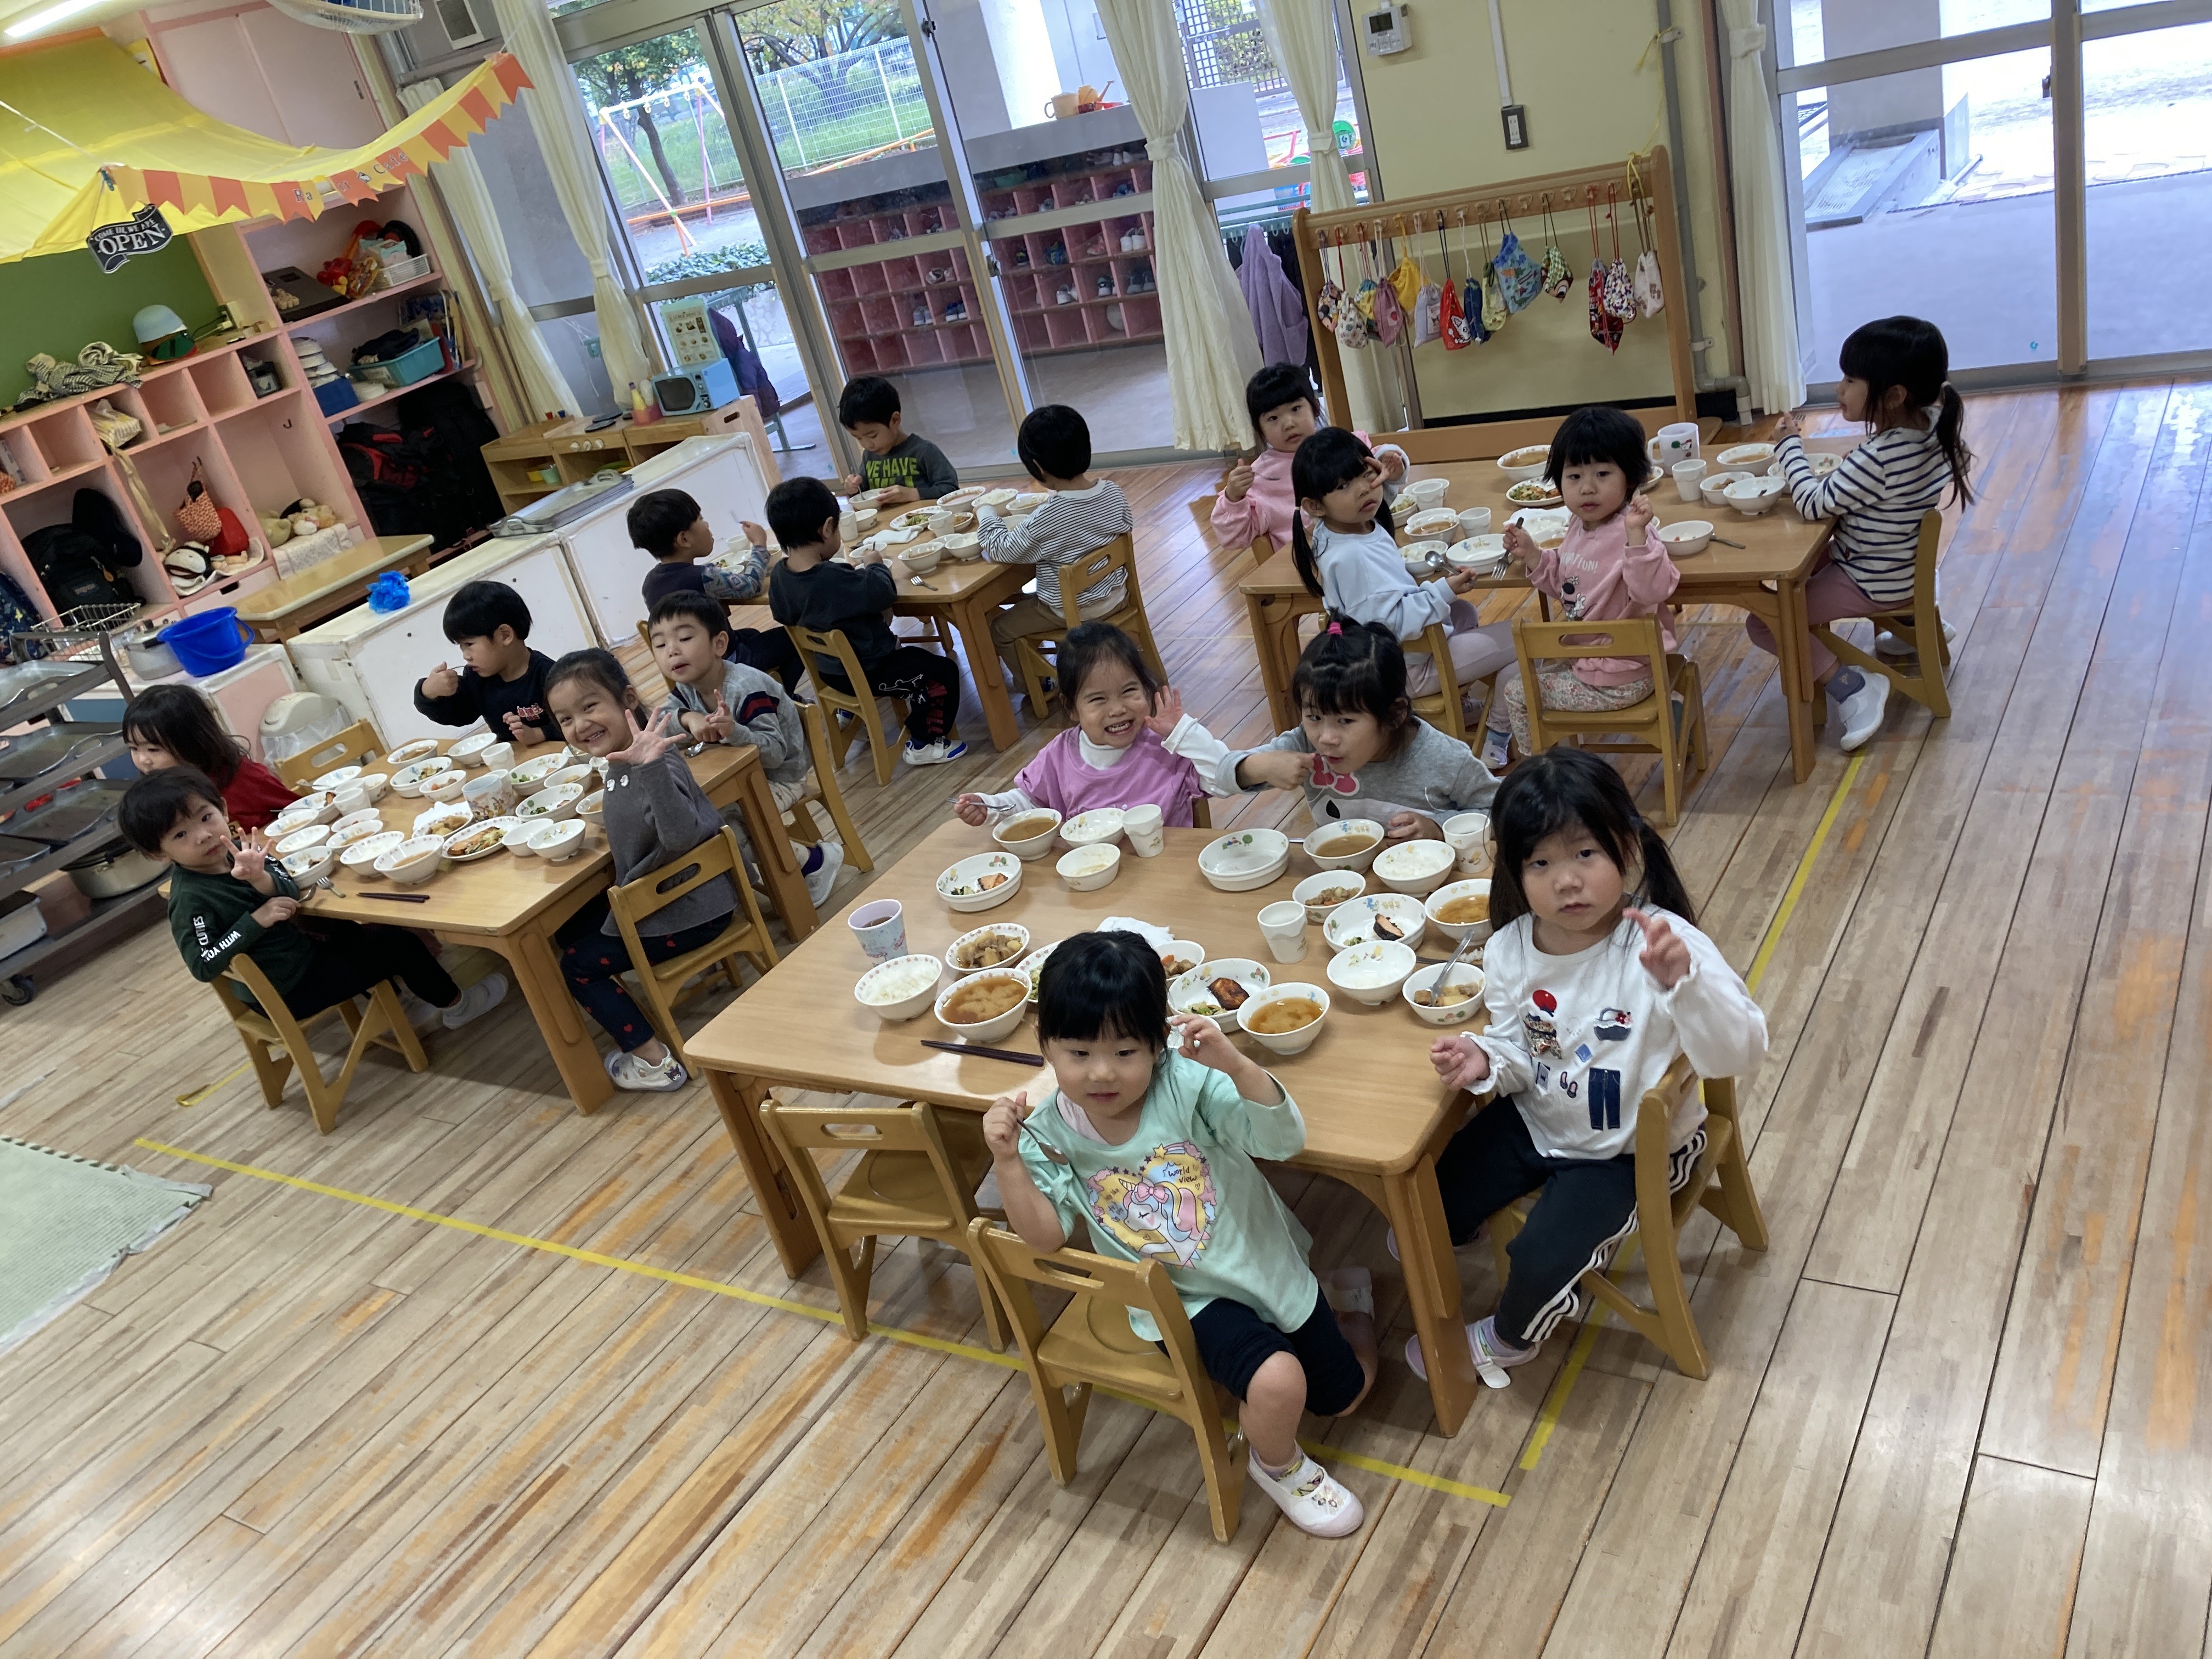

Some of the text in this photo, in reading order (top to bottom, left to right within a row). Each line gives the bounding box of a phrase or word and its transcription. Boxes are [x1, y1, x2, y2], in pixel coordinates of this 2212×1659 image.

[94, 229, 113, 242] COME
[99, 223, 166, 255] OPEN
[883, 457, 919, 478] HAVE
[219, 930, 241, 950] WITH
[1168, 1166, 1190, 1177] world
[1179, 1175, 1198, 1183] view
